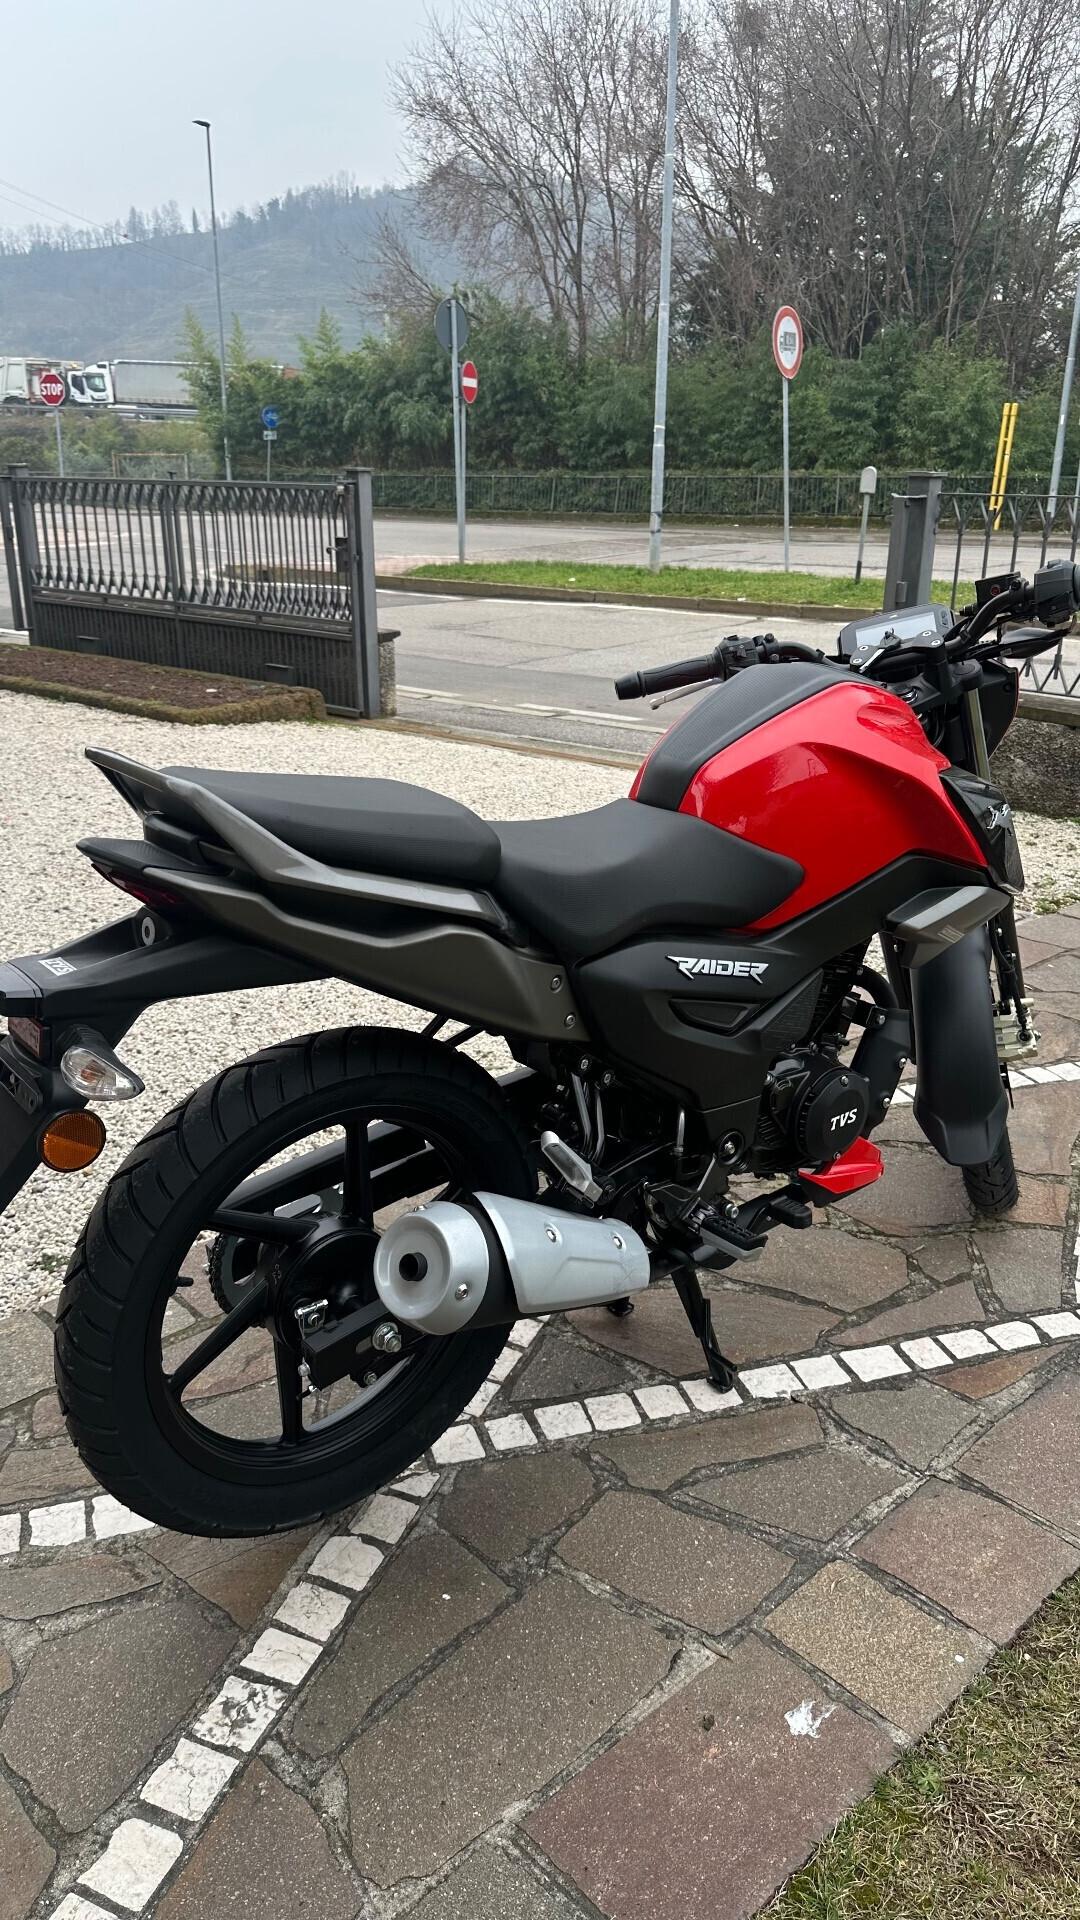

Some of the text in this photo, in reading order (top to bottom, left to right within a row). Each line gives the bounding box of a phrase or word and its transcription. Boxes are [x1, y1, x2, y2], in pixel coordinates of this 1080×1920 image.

[41, 383, 63, 396] STOP
[667, 955, 769, 984] RAIDER
[830, 1108, 858, 1131] TVS
